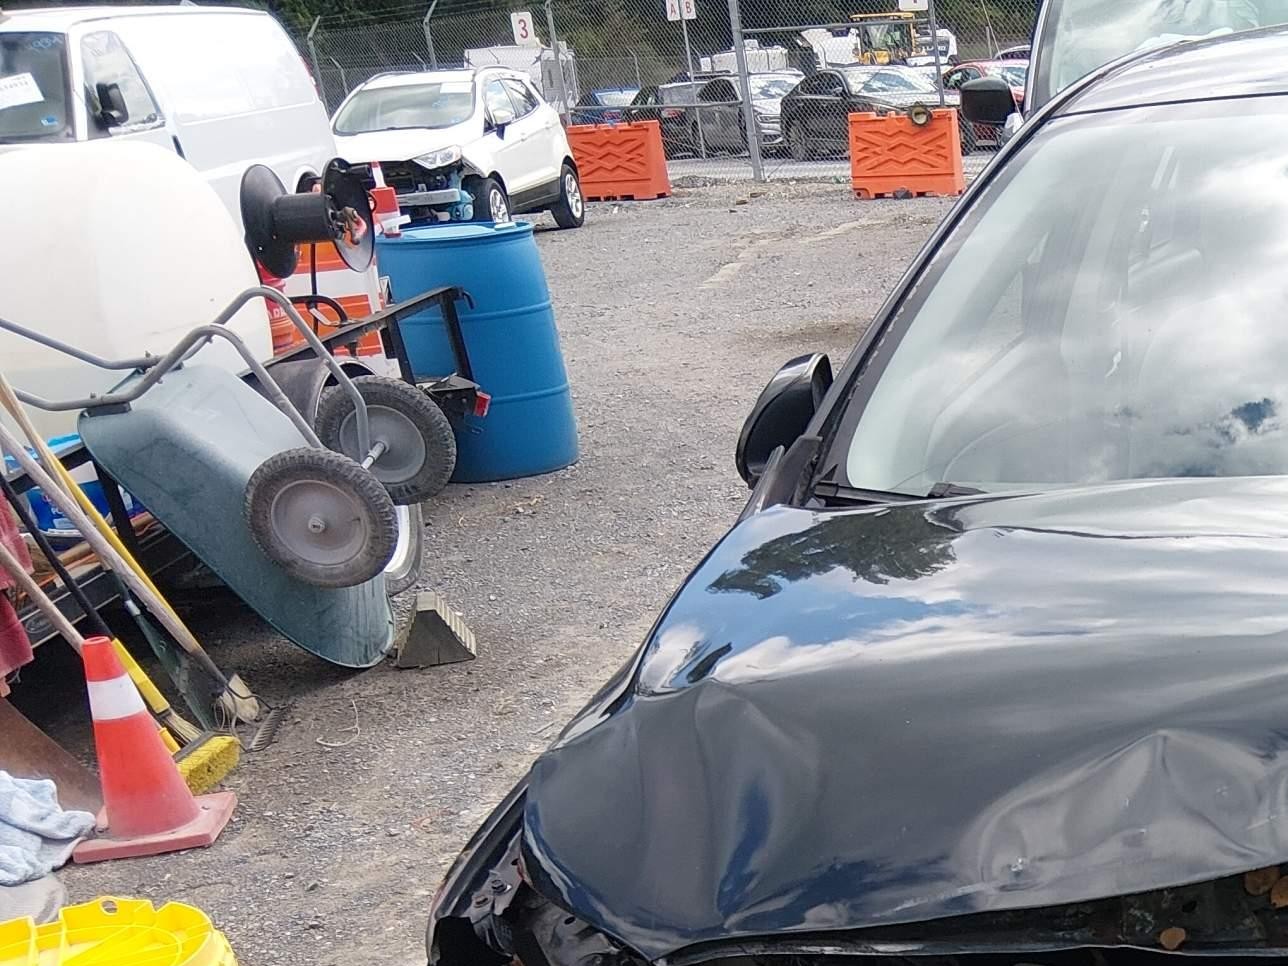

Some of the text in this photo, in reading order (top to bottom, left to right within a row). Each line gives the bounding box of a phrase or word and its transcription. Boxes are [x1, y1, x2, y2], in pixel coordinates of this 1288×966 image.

[670, 1, 692, 15] A B
[518, 18, 529, 39] 3
